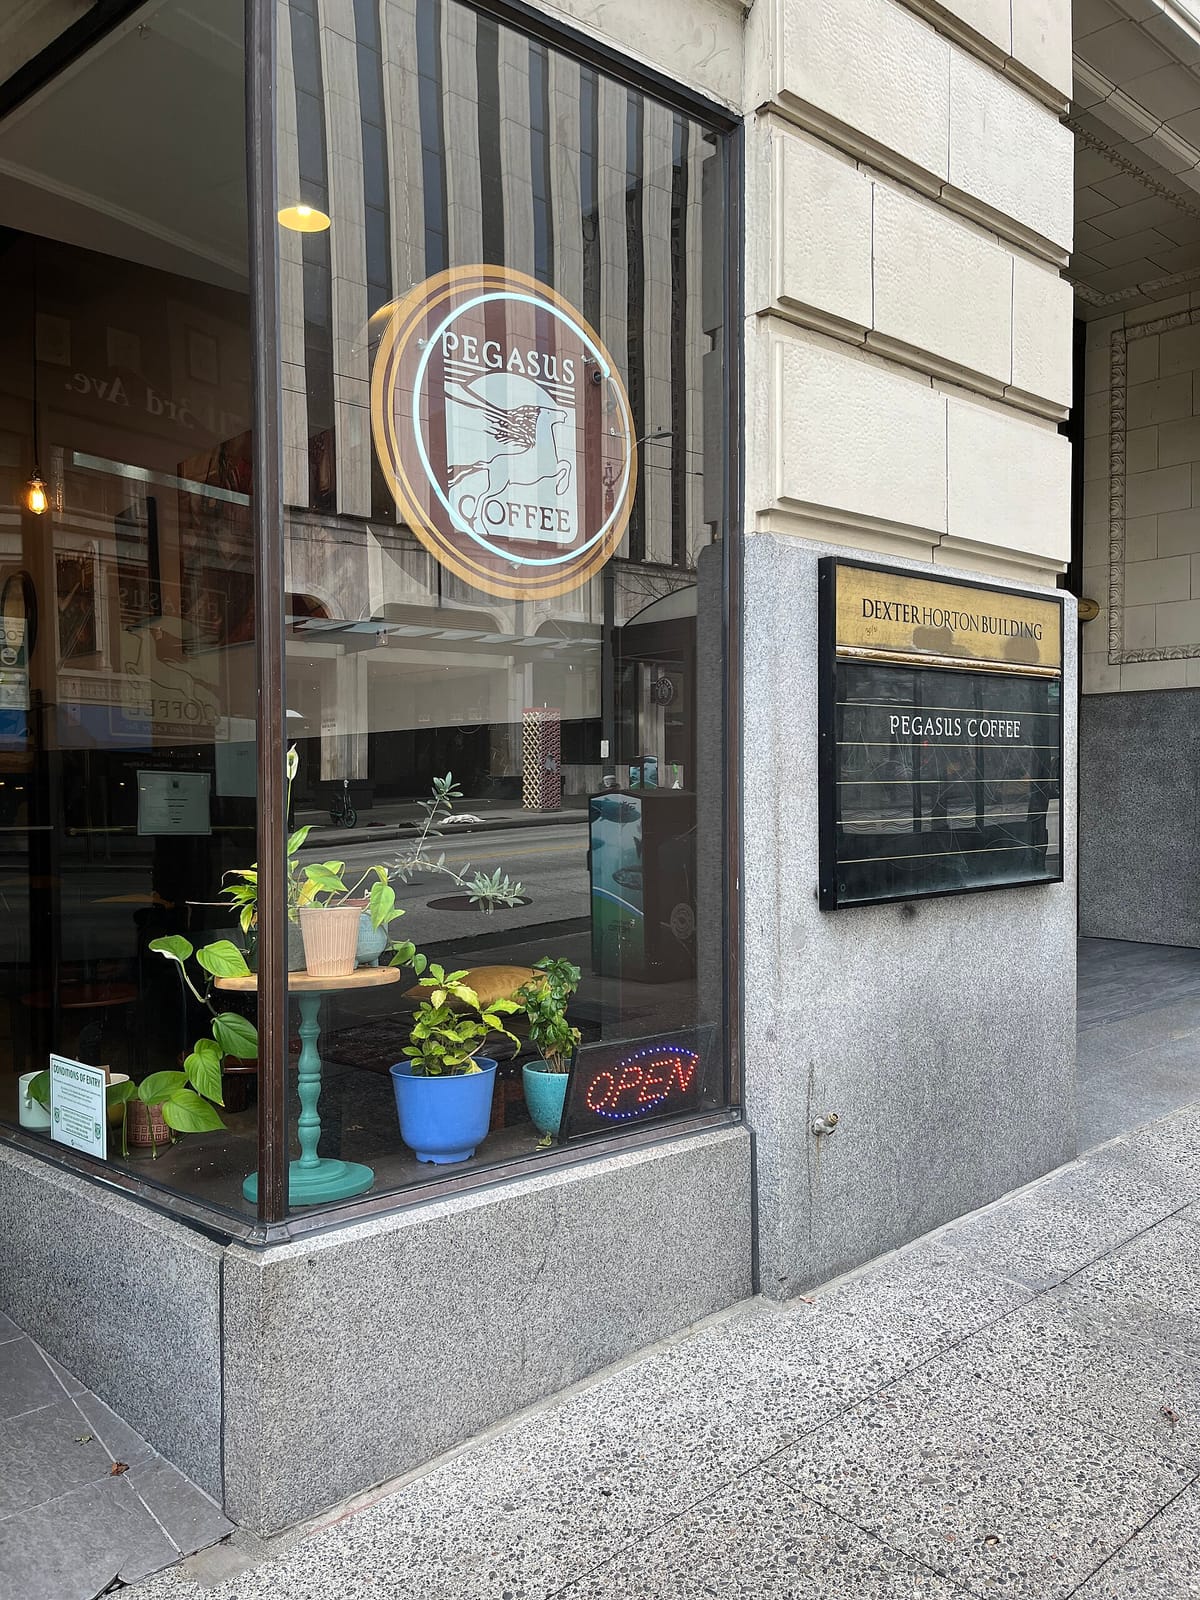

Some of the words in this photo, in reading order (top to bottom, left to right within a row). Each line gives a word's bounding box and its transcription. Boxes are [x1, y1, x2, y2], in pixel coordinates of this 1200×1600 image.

[441, 330, 576, 384] PEGASUS
[458, 494, 572, 534] COFFEE
[862, 598, 921, 625] DEXTER
[922, 606, 979, 632] HORTON
[982, 616, 1041, 640] BUILDING
[890, 715, 961, 737] PEGASUS
[967, 718, 1021, 738] COFFEE
[53, 1064, 79, 1081] CONDITIONS
[79, 1072, 86, 1083] OF
[86, 1075, 101, 1088] ENTRY
[588, 1055, 699, 1110] OPEN
